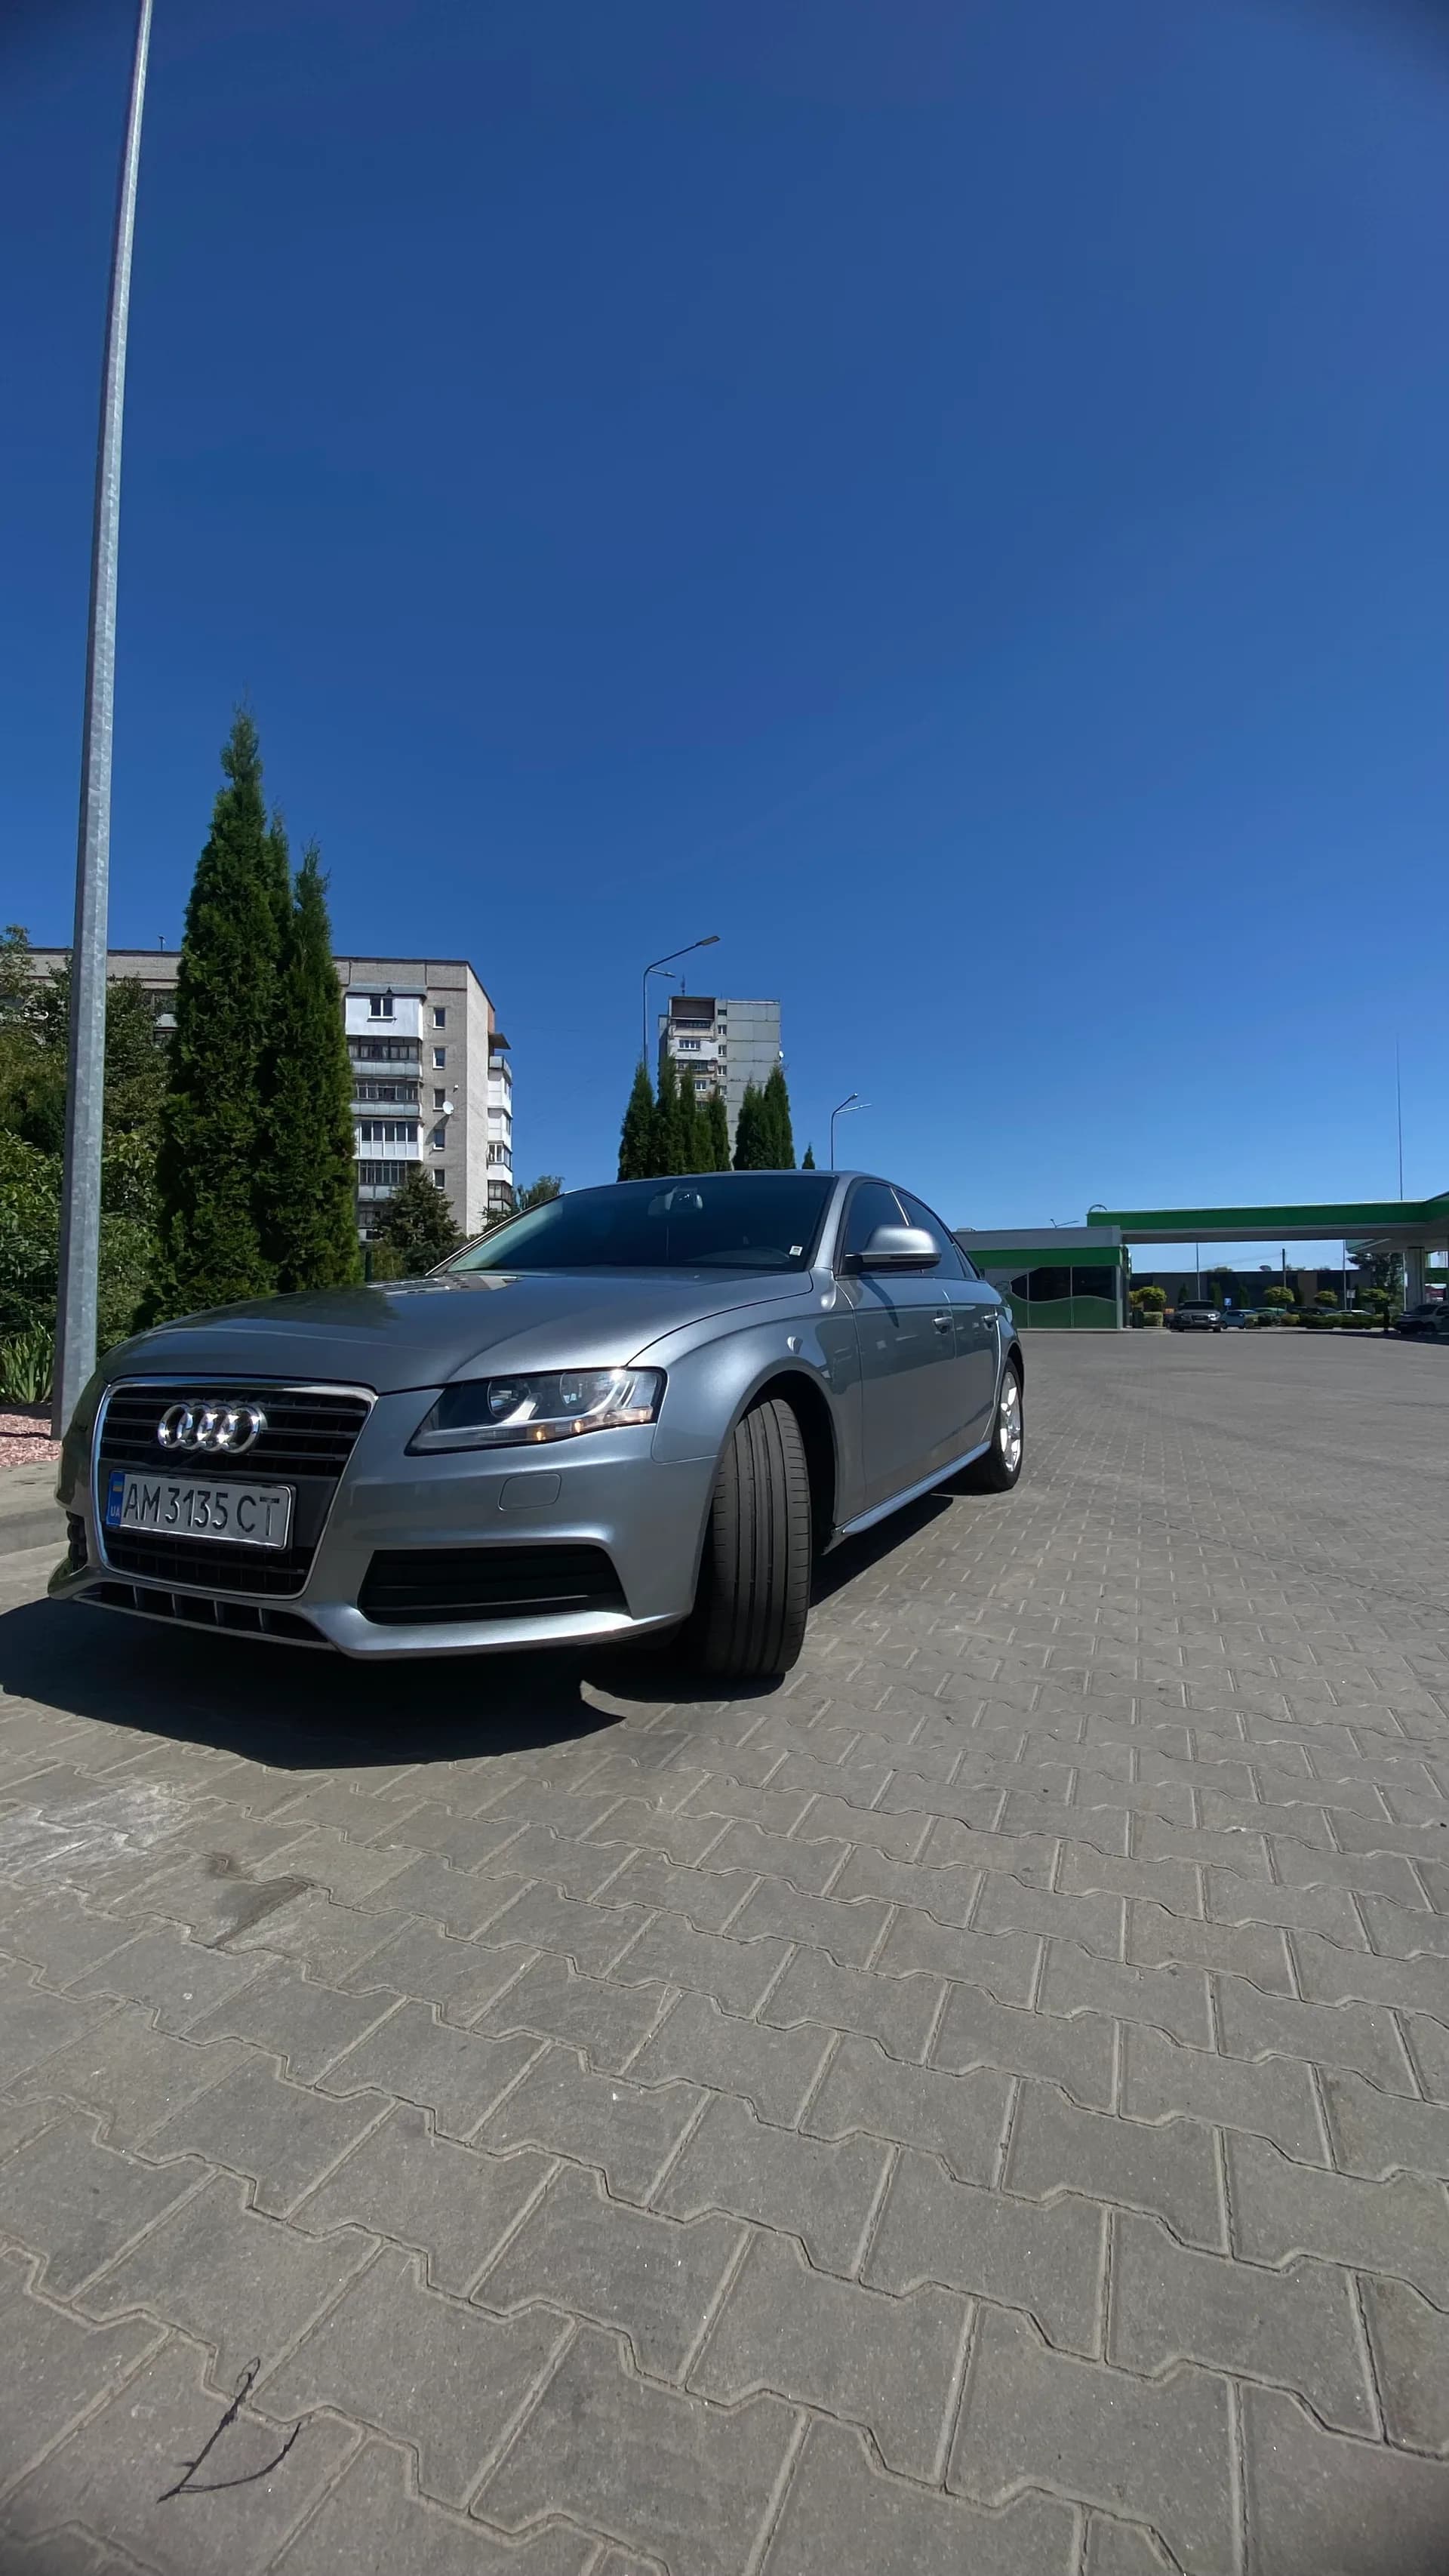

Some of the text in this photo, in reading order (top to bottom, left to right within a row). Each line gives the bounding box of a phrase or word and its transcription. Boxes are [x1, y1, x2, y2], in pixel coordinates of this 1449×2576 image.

[109, 1505, 121, 1518] UA
[123, 1483, 280, 1536] AM 3135 CT
